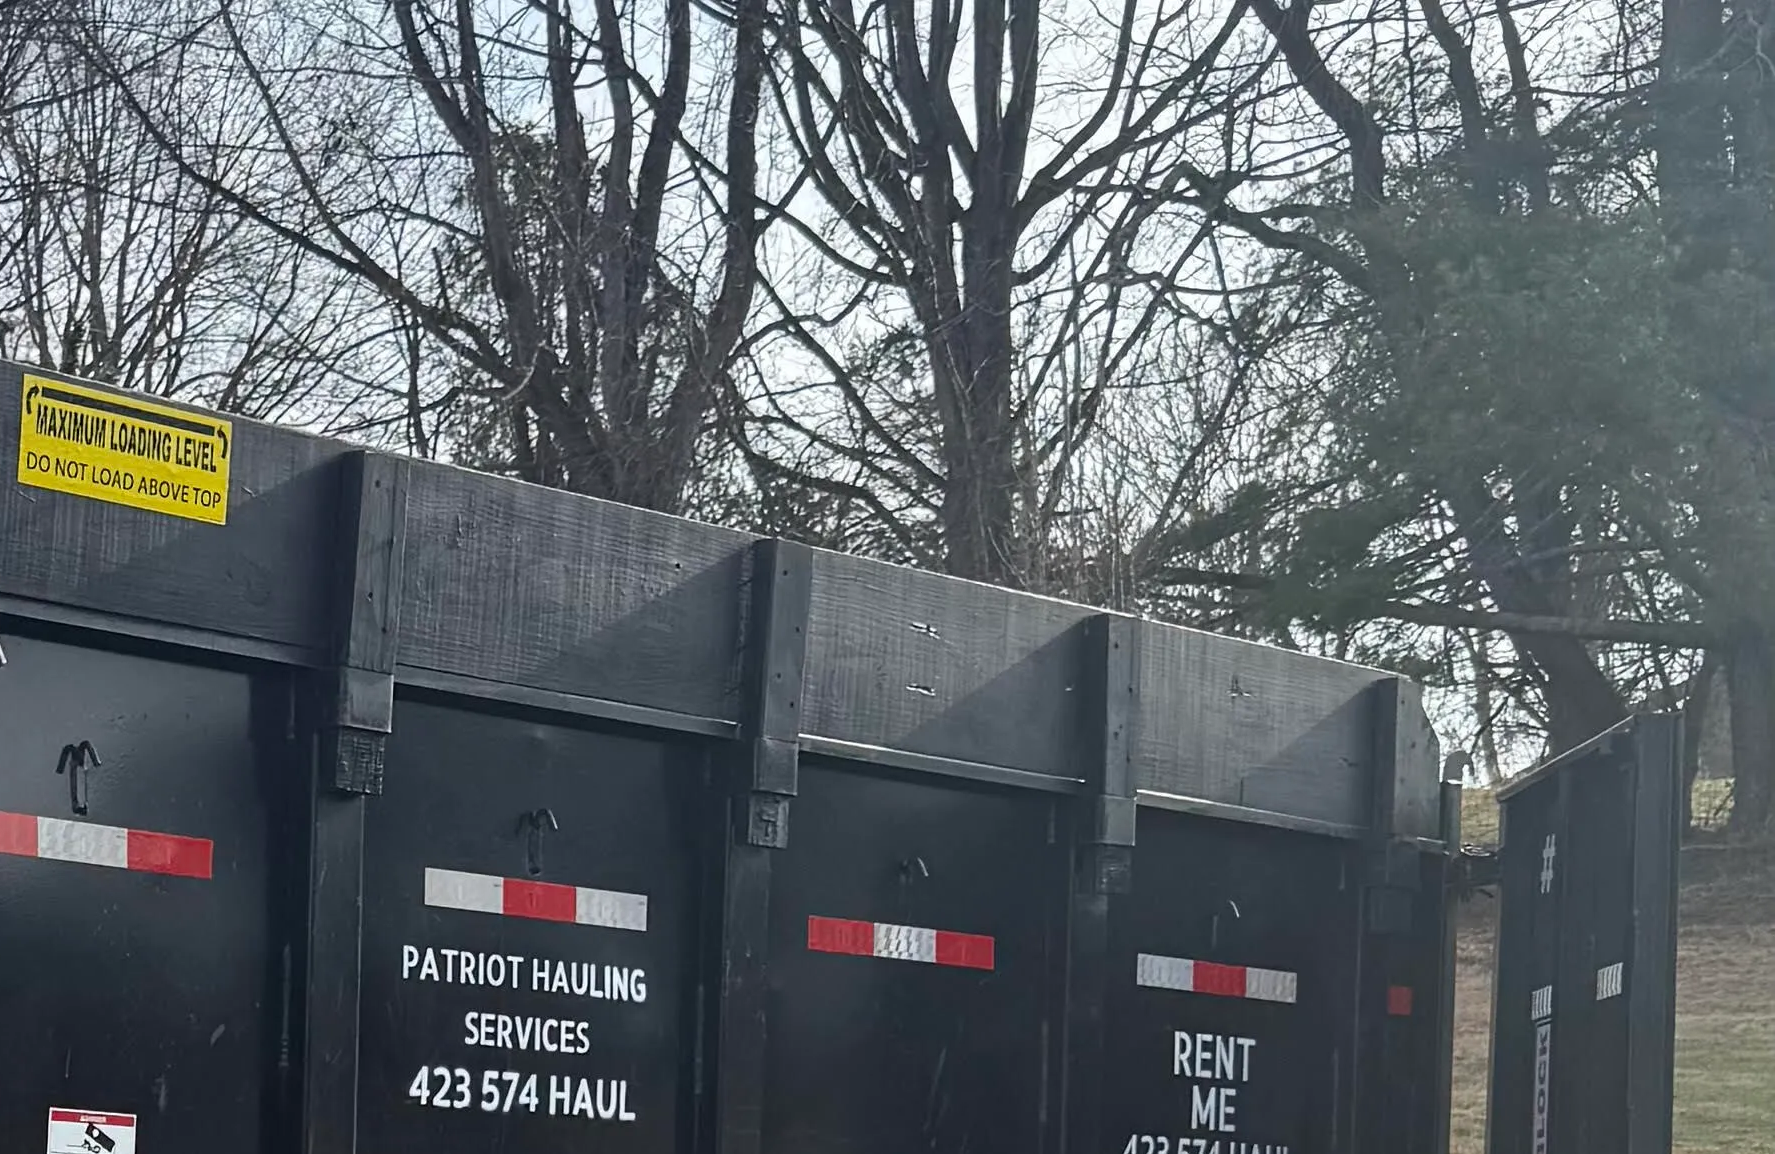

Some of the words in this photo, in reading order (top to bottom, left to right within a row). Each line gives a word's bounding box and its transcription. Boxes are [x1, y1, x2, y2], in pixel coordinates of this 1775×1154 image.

[35, 402, 107, 449] MAXIMUM
[110, 420, 172, 463] LOADING
[175, 435, 217, 473] LEVEL
[25, 451, 51, 472] DO
[55, 458, 89, 482] NOT
[92, 466, 135, 491] LOAD
[137, 477, 190, 504] ABOVE
[193, 487, 222, 510] TOP
[401, 944, 525, 989] PATRIOT
[532, 958, 648, 1003] HAULING
[464, 1011, 591, 1055] SERVICES
[1173, 1030, 1257, 1082] RENT
[408, 1065, 472, 1109] 423
[481, 1069, 539, 1113] 574
[549, 1075, 637, 1121] HAUL
[1191, 1084, 1237, 1132] ME
